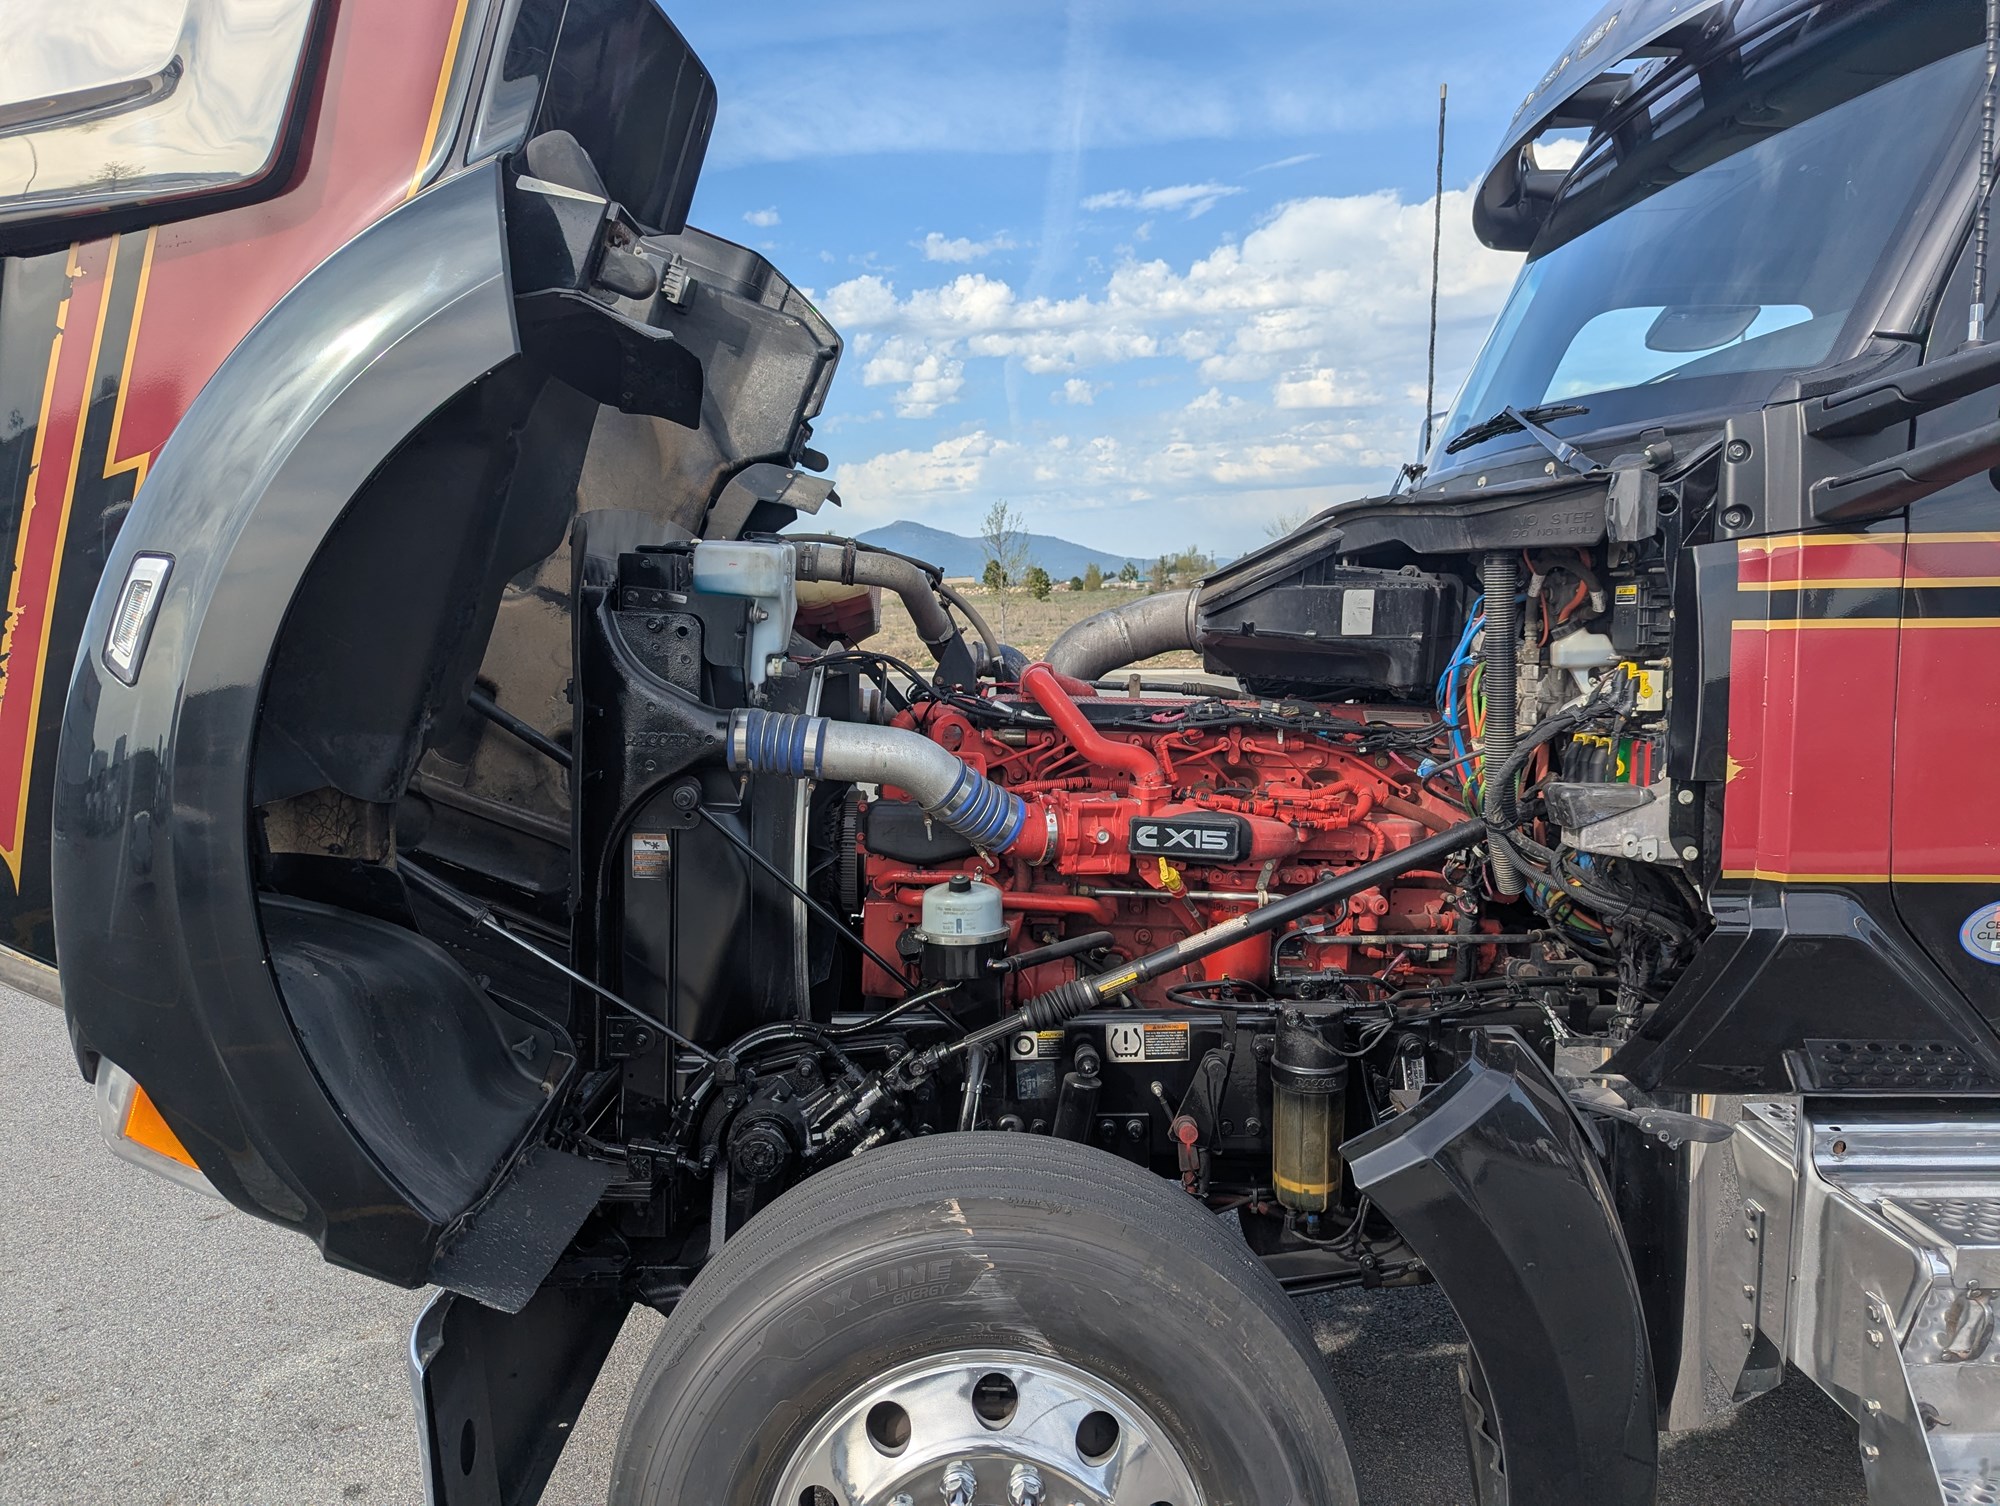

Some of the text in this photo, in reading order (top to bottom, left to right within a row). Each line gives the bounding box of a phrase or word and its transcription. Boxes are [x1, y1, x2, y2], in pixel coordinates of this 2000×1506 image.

[1514, 511, 1595, 526] NO STEP
[1511, 526, 1597, 538] DO NOT PULL
[1163, 827, 1228, 850] X15
[822, 1258, 953, 1318] X LINE
[893, 1283, 949, 1305] ENERGY
